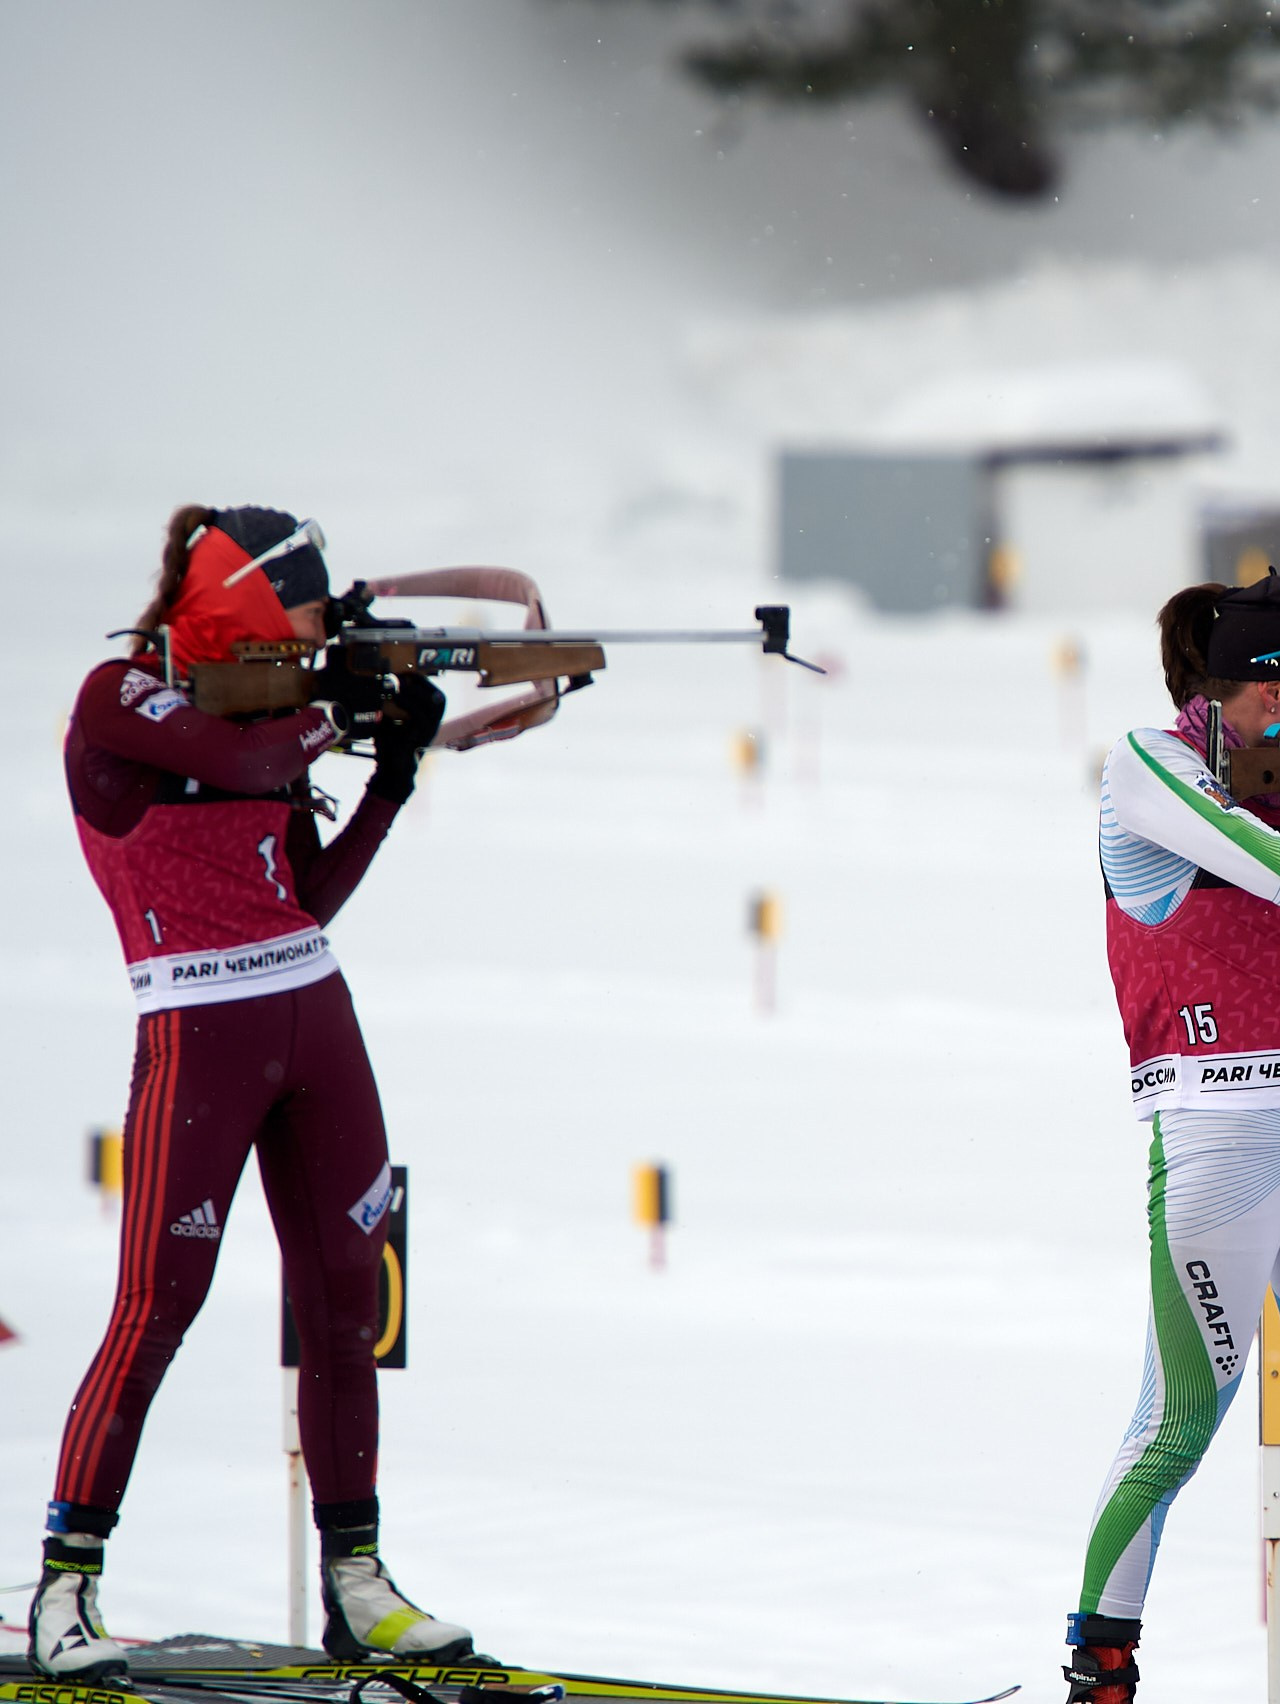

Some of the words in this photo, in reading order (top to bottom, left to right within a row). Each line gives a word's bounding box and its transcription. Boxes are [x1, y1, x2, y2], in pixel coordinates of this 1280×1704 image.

[418, 649, 475, 666] PARI
[258, 833, 287, 901] 1
[145, 908, 162, 945] 1
[172, 962, 219, 981] PARI
[1178, 1002, 1219, 1046] 15
[1131, 1067, 1176, 1093] ОССИИ
[1201, 1066, 1253, 1084] PARI
[170, 1223, 220, 1239] adidas
[1186, 1260, 1234, 1350] CRAFT
